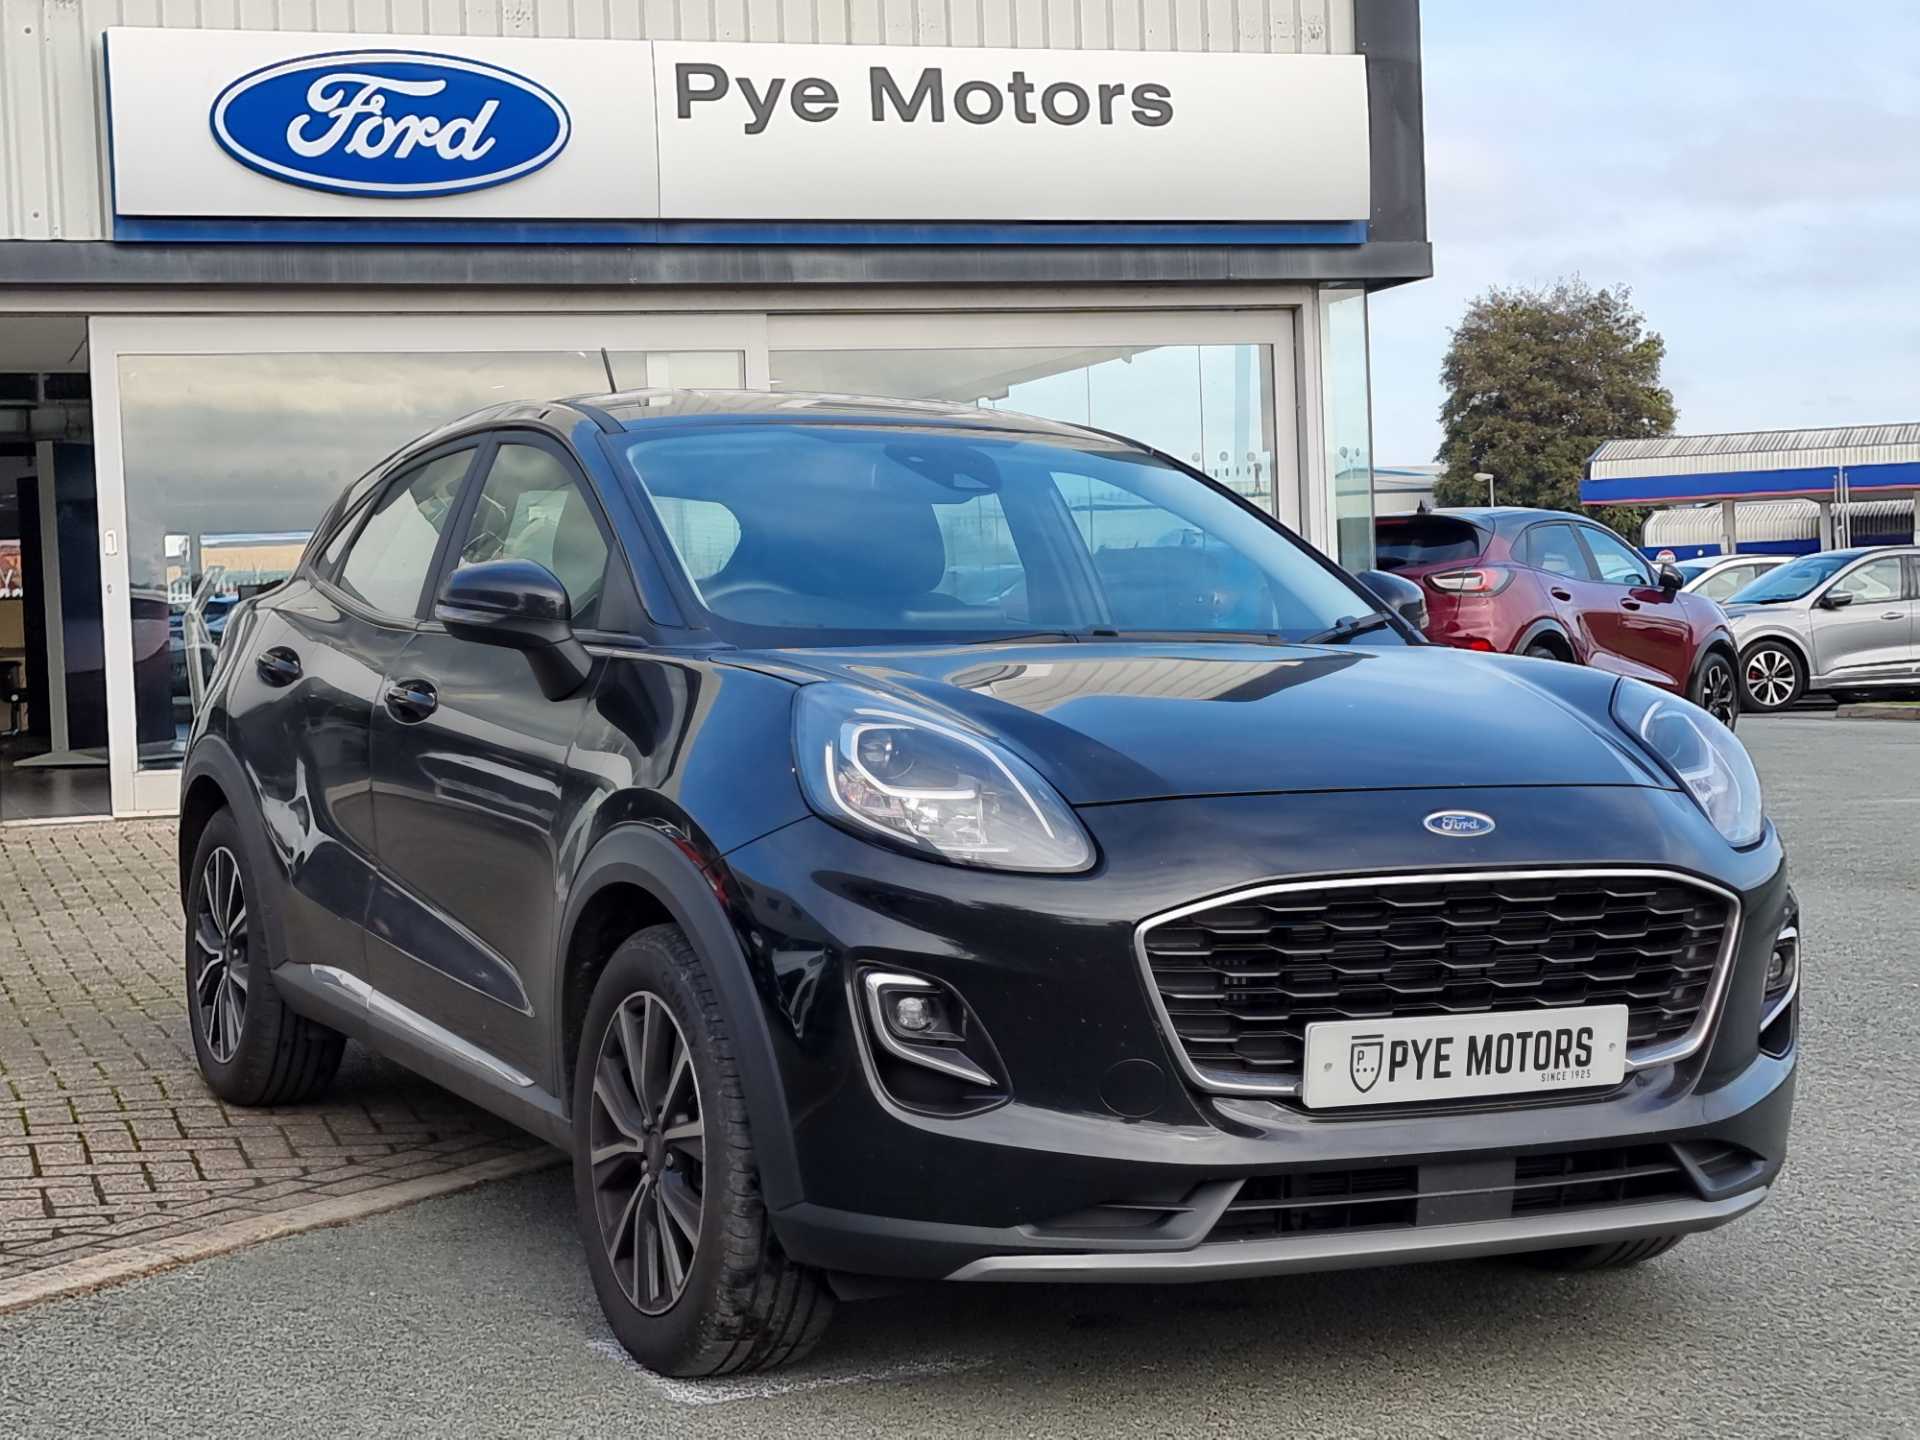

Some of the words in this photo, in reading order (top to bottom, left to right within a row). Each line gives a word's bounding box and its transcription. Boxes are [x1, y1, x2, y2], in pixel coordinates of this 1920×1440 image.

[286, 73, 499, 160] Ford
[676, 62, 839, 134] Pye
[870, 66, 1174, 126] Motors
[1441, 816, 1478, 830] Ford
[1388, 1037, 1454, 1082] PYE
[1466, 1026, 1594, 1077] MOTORS
[1541, 1071, 1567, 1082] SINCE
[1571, 1069, 1591, 1080] 1925
